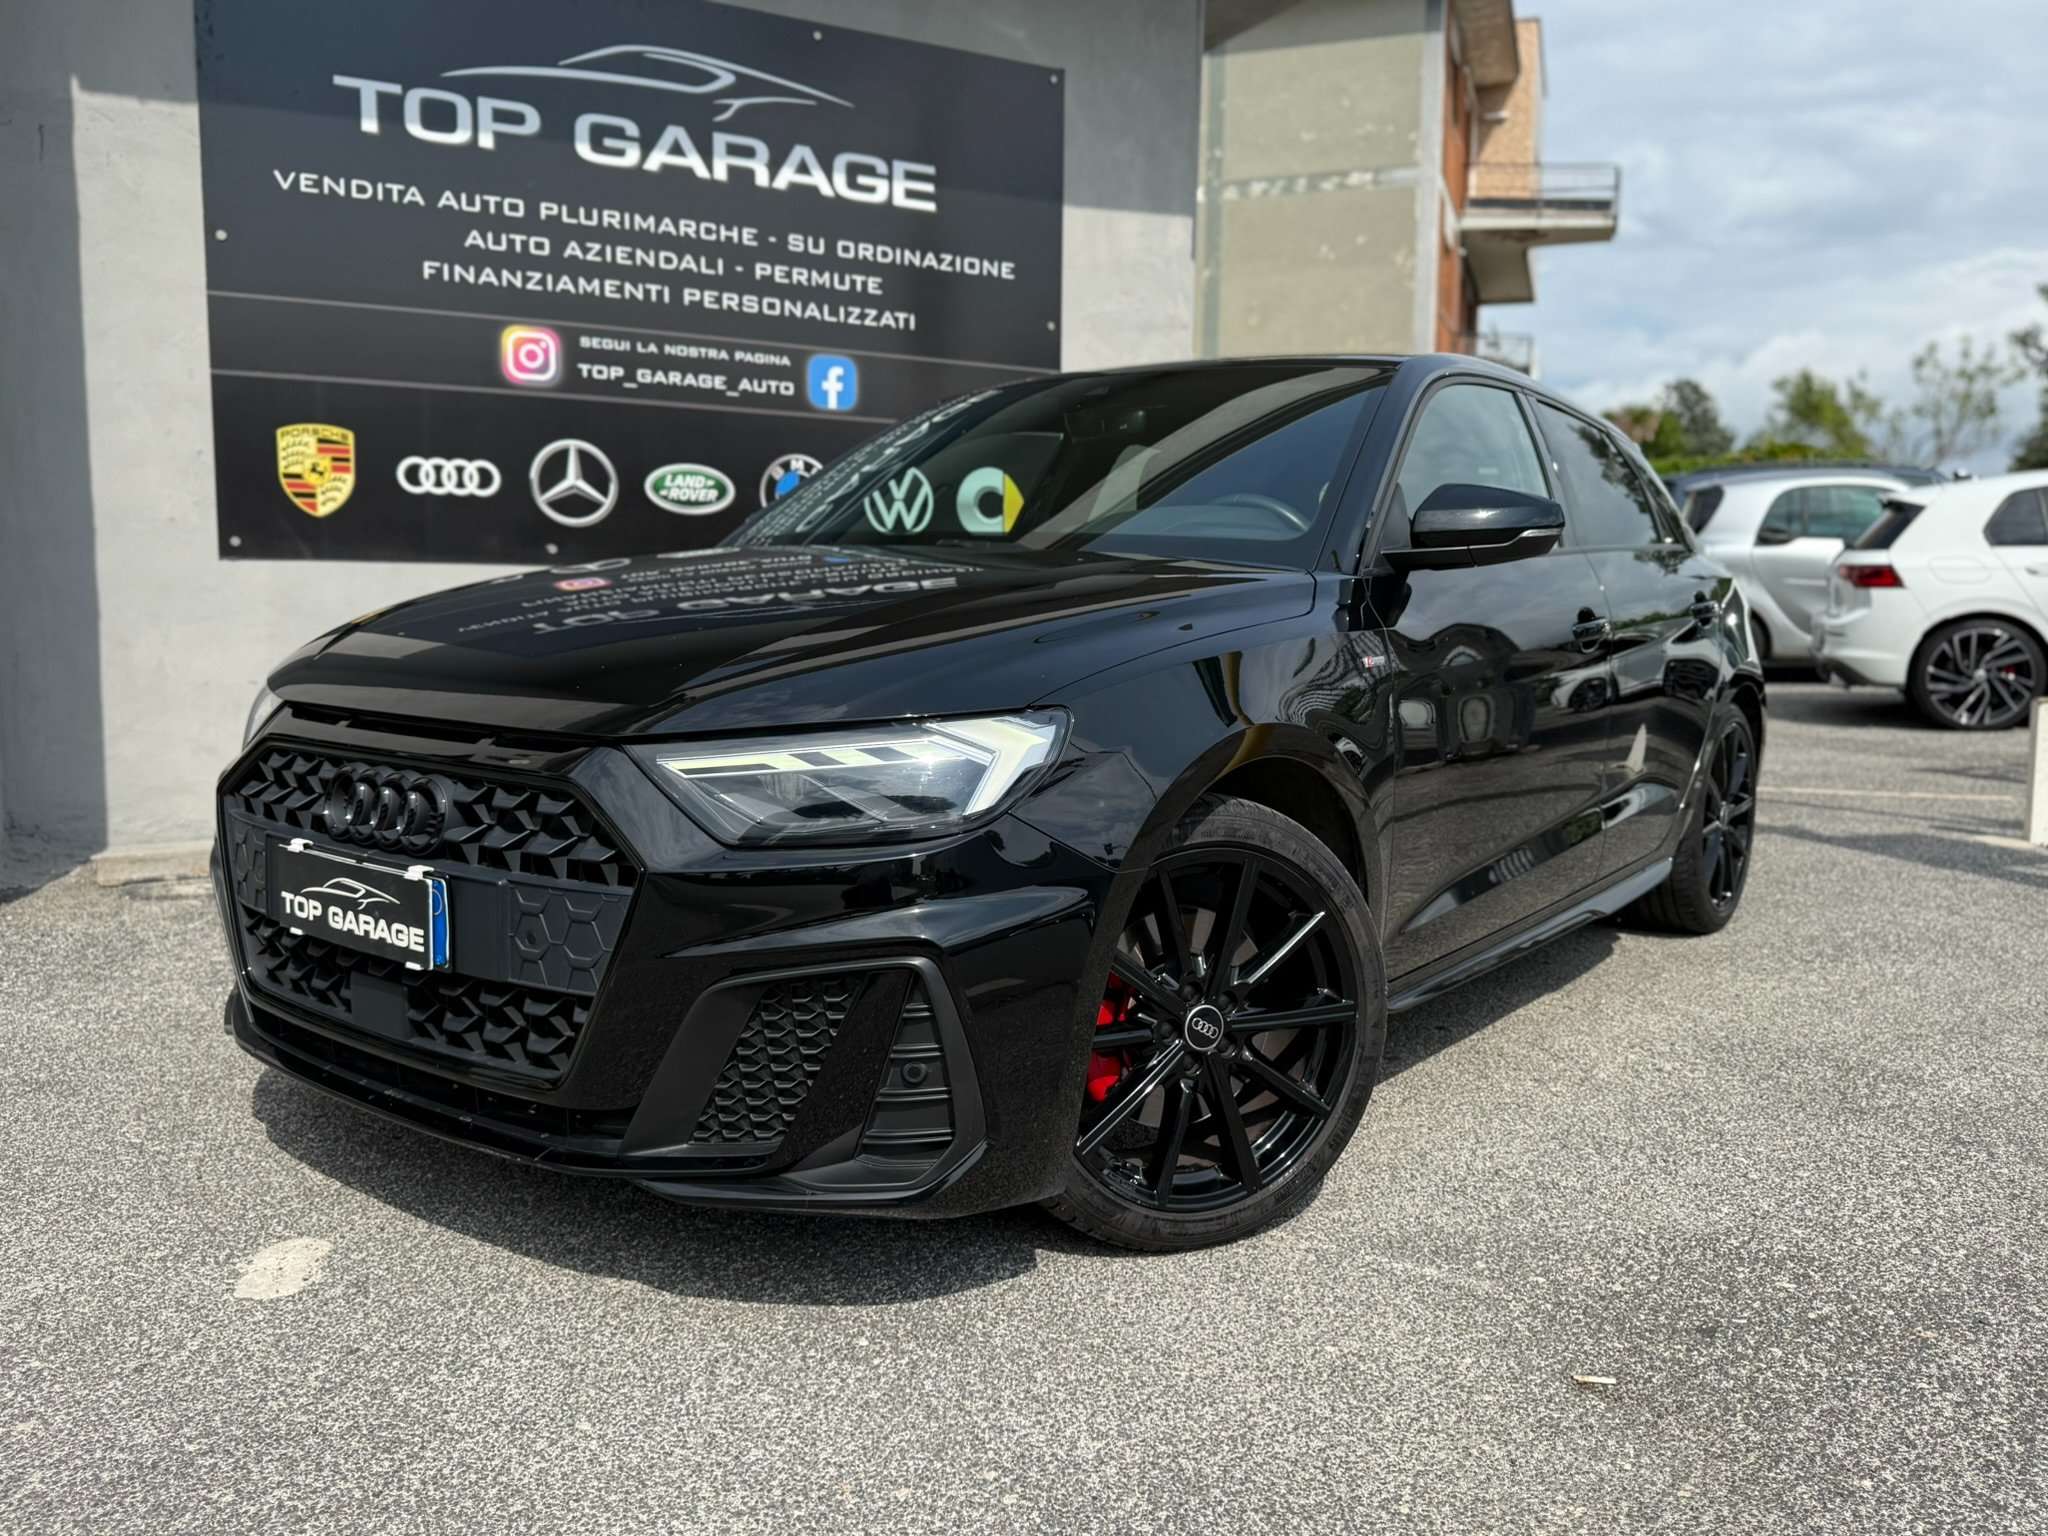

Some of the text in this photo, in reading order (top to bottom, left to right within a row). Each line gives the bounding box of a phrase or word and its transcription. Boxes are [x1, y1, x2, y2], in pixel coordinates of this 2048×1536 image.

[332, 74, 937, 212] TOP GARAGE
[272, 169, 425, 207] VENDITA
[436, 189, 525, 219] AUTO
[539, 201, 759, 247] PLURIMARCHE
[787, 233, 826, 255] SU
[836, 241, 1016, 280] ORDINAZIONE
[464, 229, 551, 257] AUTO
[562, 240, 724, 276] AZIENDALI
[755, 263, 884, 296] PERMUTE
[422, 261, 916, 331] FINANZIAMENTI PERSONALIZZATI
[578, 335, 792, 366] SEGUI LA NOSTRA PAGINA
[578, 363, 795, 396] TOP_GARAGE_AUTO
[664, 473, 706, 488] LAND
[667, 487, 719, 502] ROVER
[280, 891, 425, 953] TOP GARAGE
